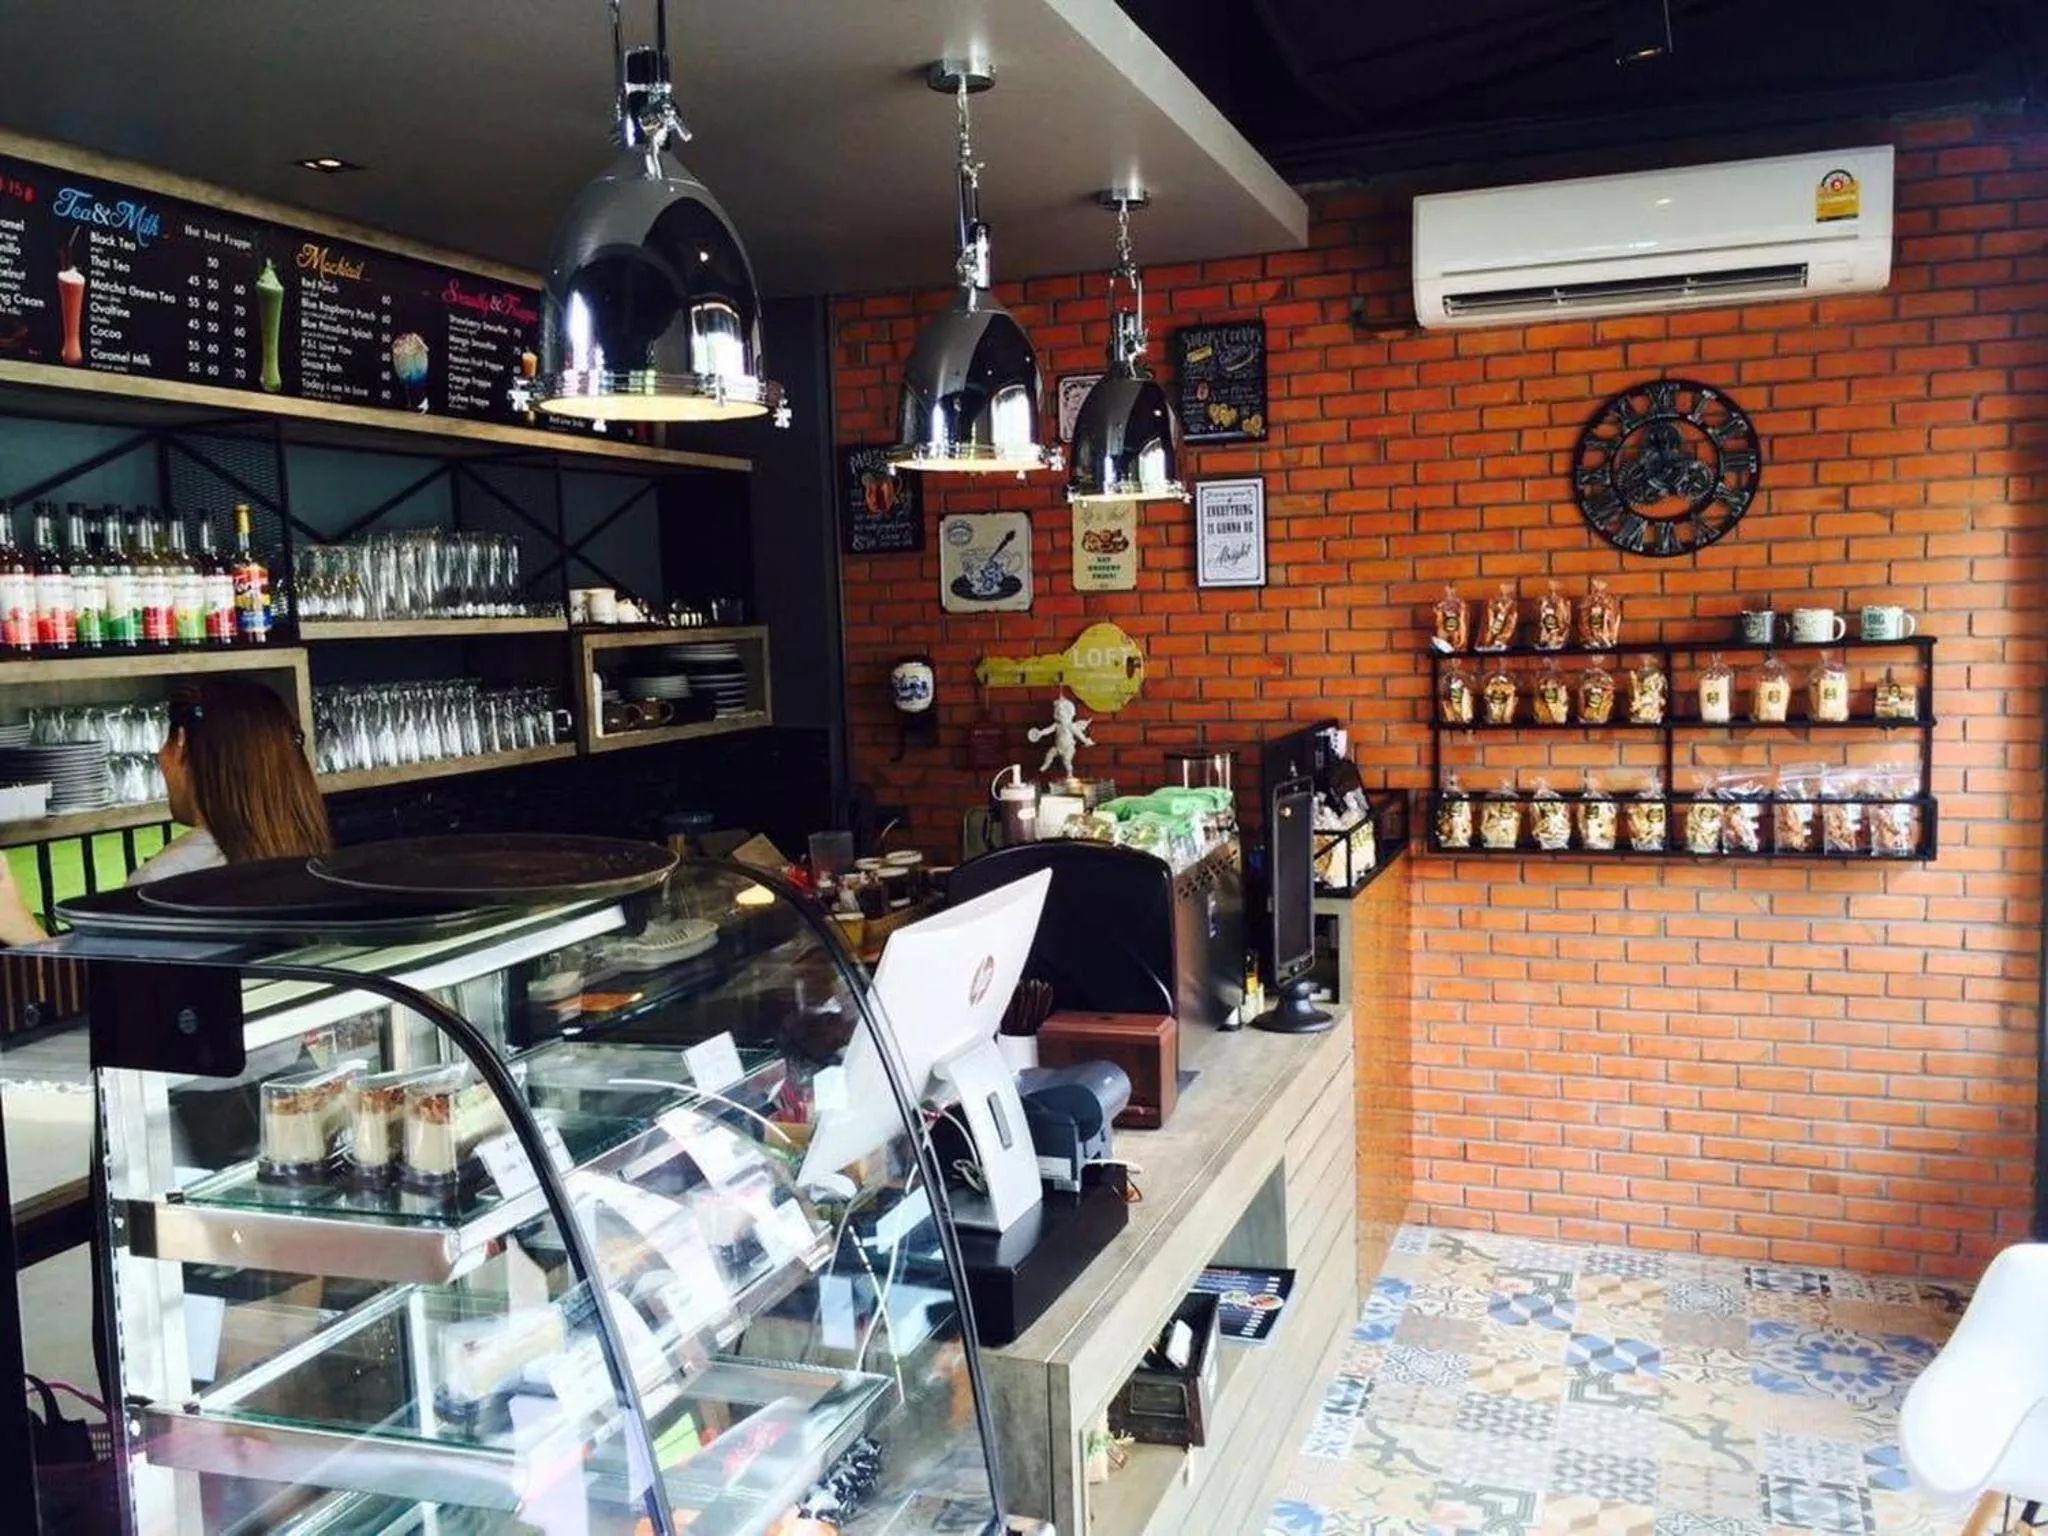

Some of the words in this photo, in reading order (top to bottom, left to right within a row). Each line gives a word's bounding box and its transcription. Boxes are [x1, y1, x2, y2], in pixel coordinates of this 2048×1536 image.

[91, 231, 117, 247] Black
[119, 236, 136, 252] Tea
[91, 255, 110, 269] Thai
[113, 259, 131, 273] Tea
[187, 275, 200, 287] 45
[13, 293, 45, 308] Cream
[91, 279, 127, 295] Matcha
[129, 285, 157, 300] Green
[159, 291, 176, 304] Tea
[90, 301, 131, 318] Ovaltine
[187, 318, 200, 330] 45
[90, 324, 123, 340] Cocoa
[90, 347, 131, 364] Caramel
[132, 353, 152, 368] Milk
